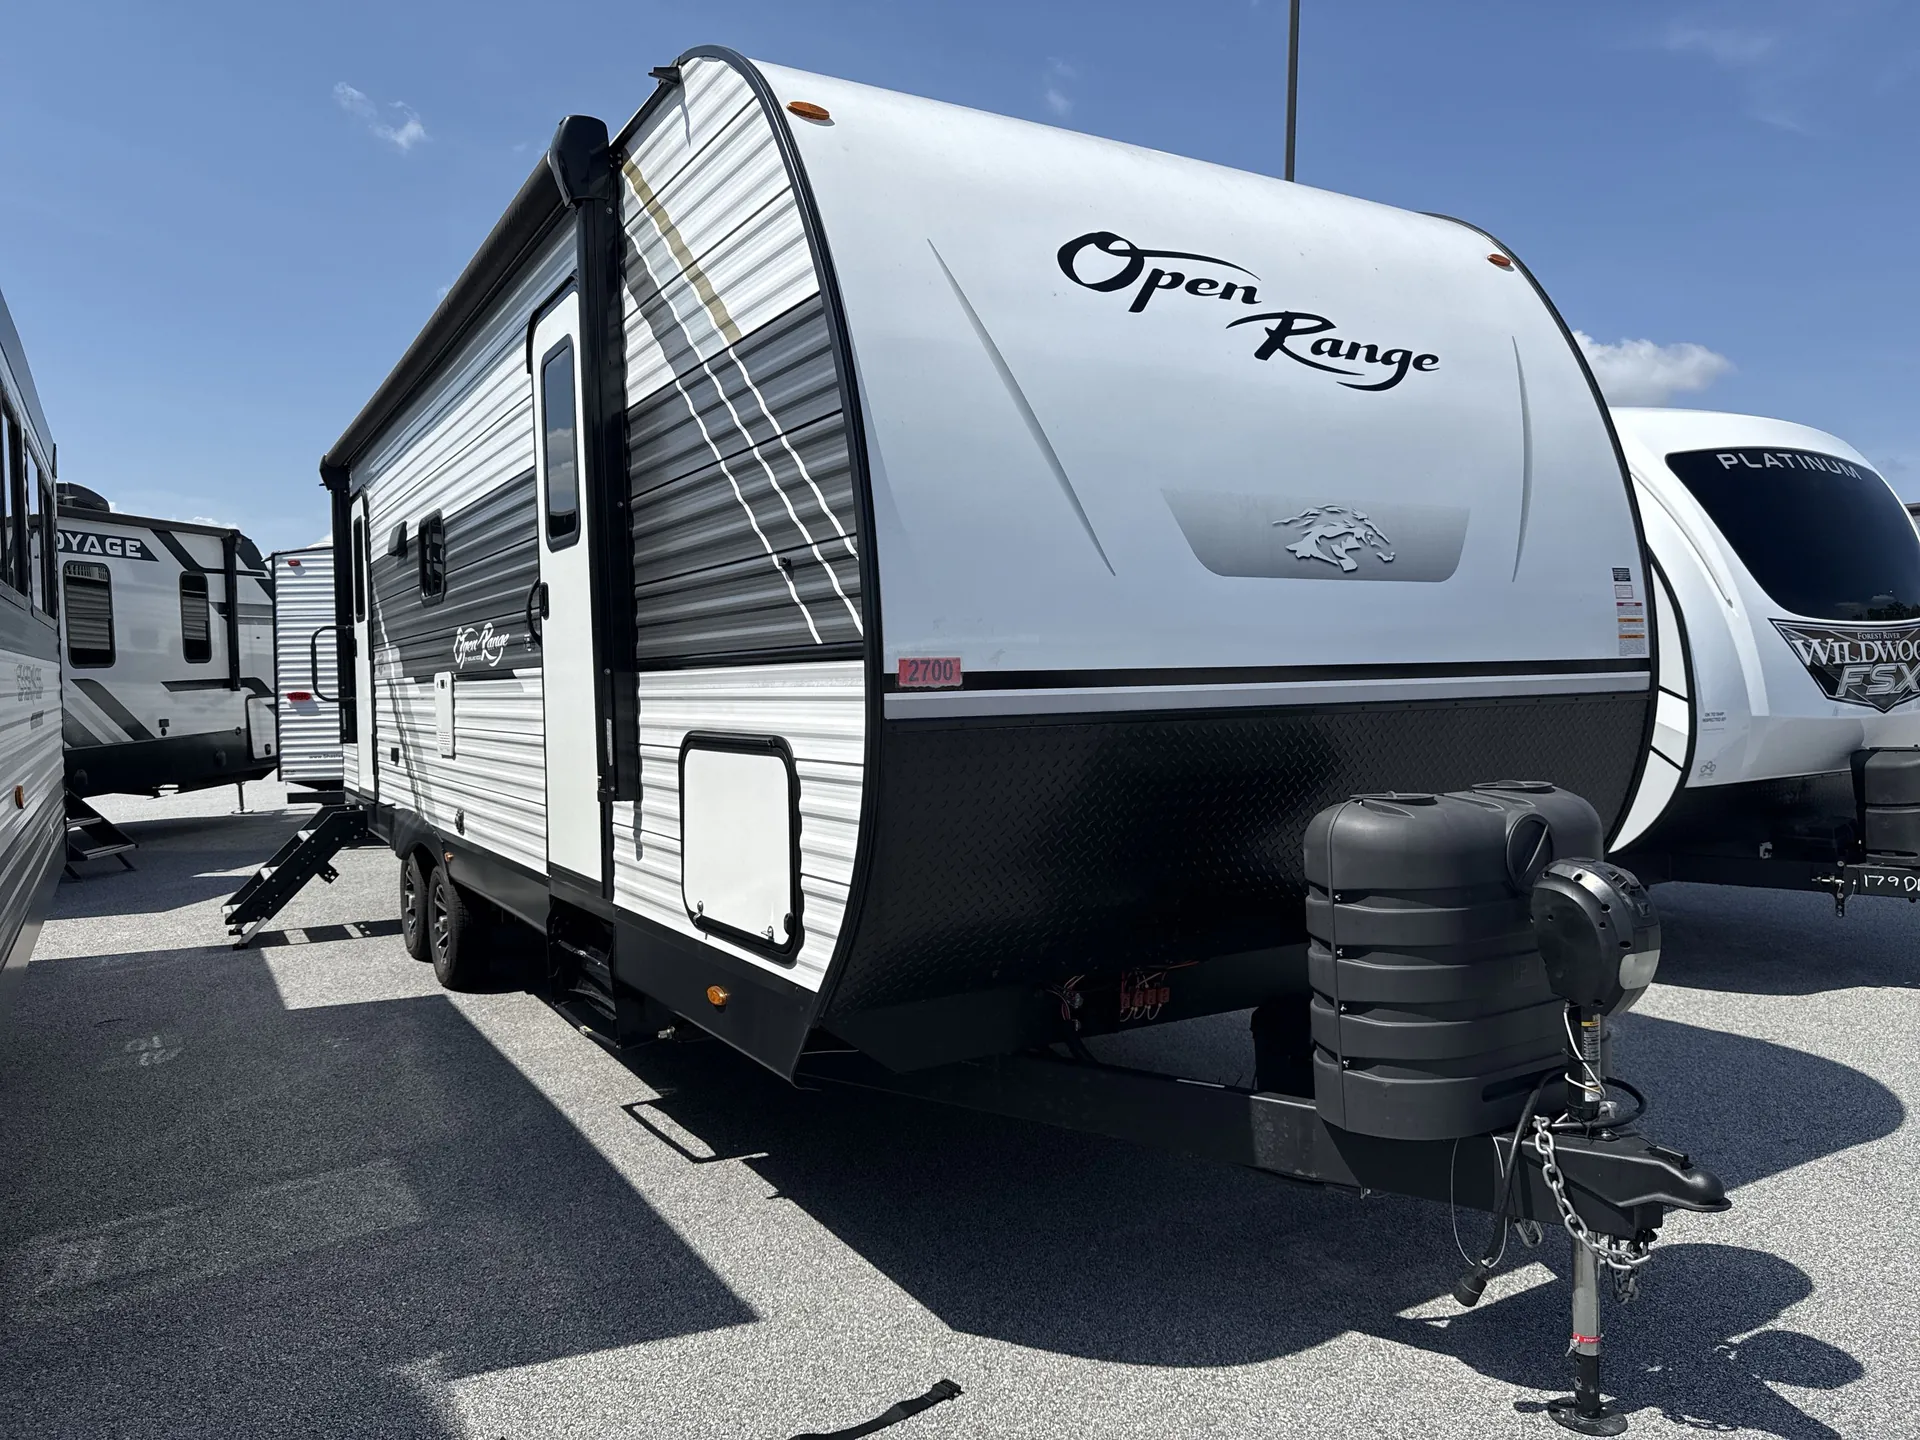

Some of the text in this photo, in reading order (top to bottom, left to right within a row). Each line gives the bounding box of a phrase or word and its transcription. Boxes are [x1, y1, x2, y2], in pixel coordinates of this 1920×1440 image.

[1057, 231, 1262, 313] Open
[1225, 311, 1440, 391] Range
[1716, 452, 1862, 480] PLATINUM
[453, 622, 510, 669] Open Range
[1857, 631, 1900, 640] FOREST RIVER
[908, 659, 953, 682] 2700
[1835, 662, 1920, 697] FSX
